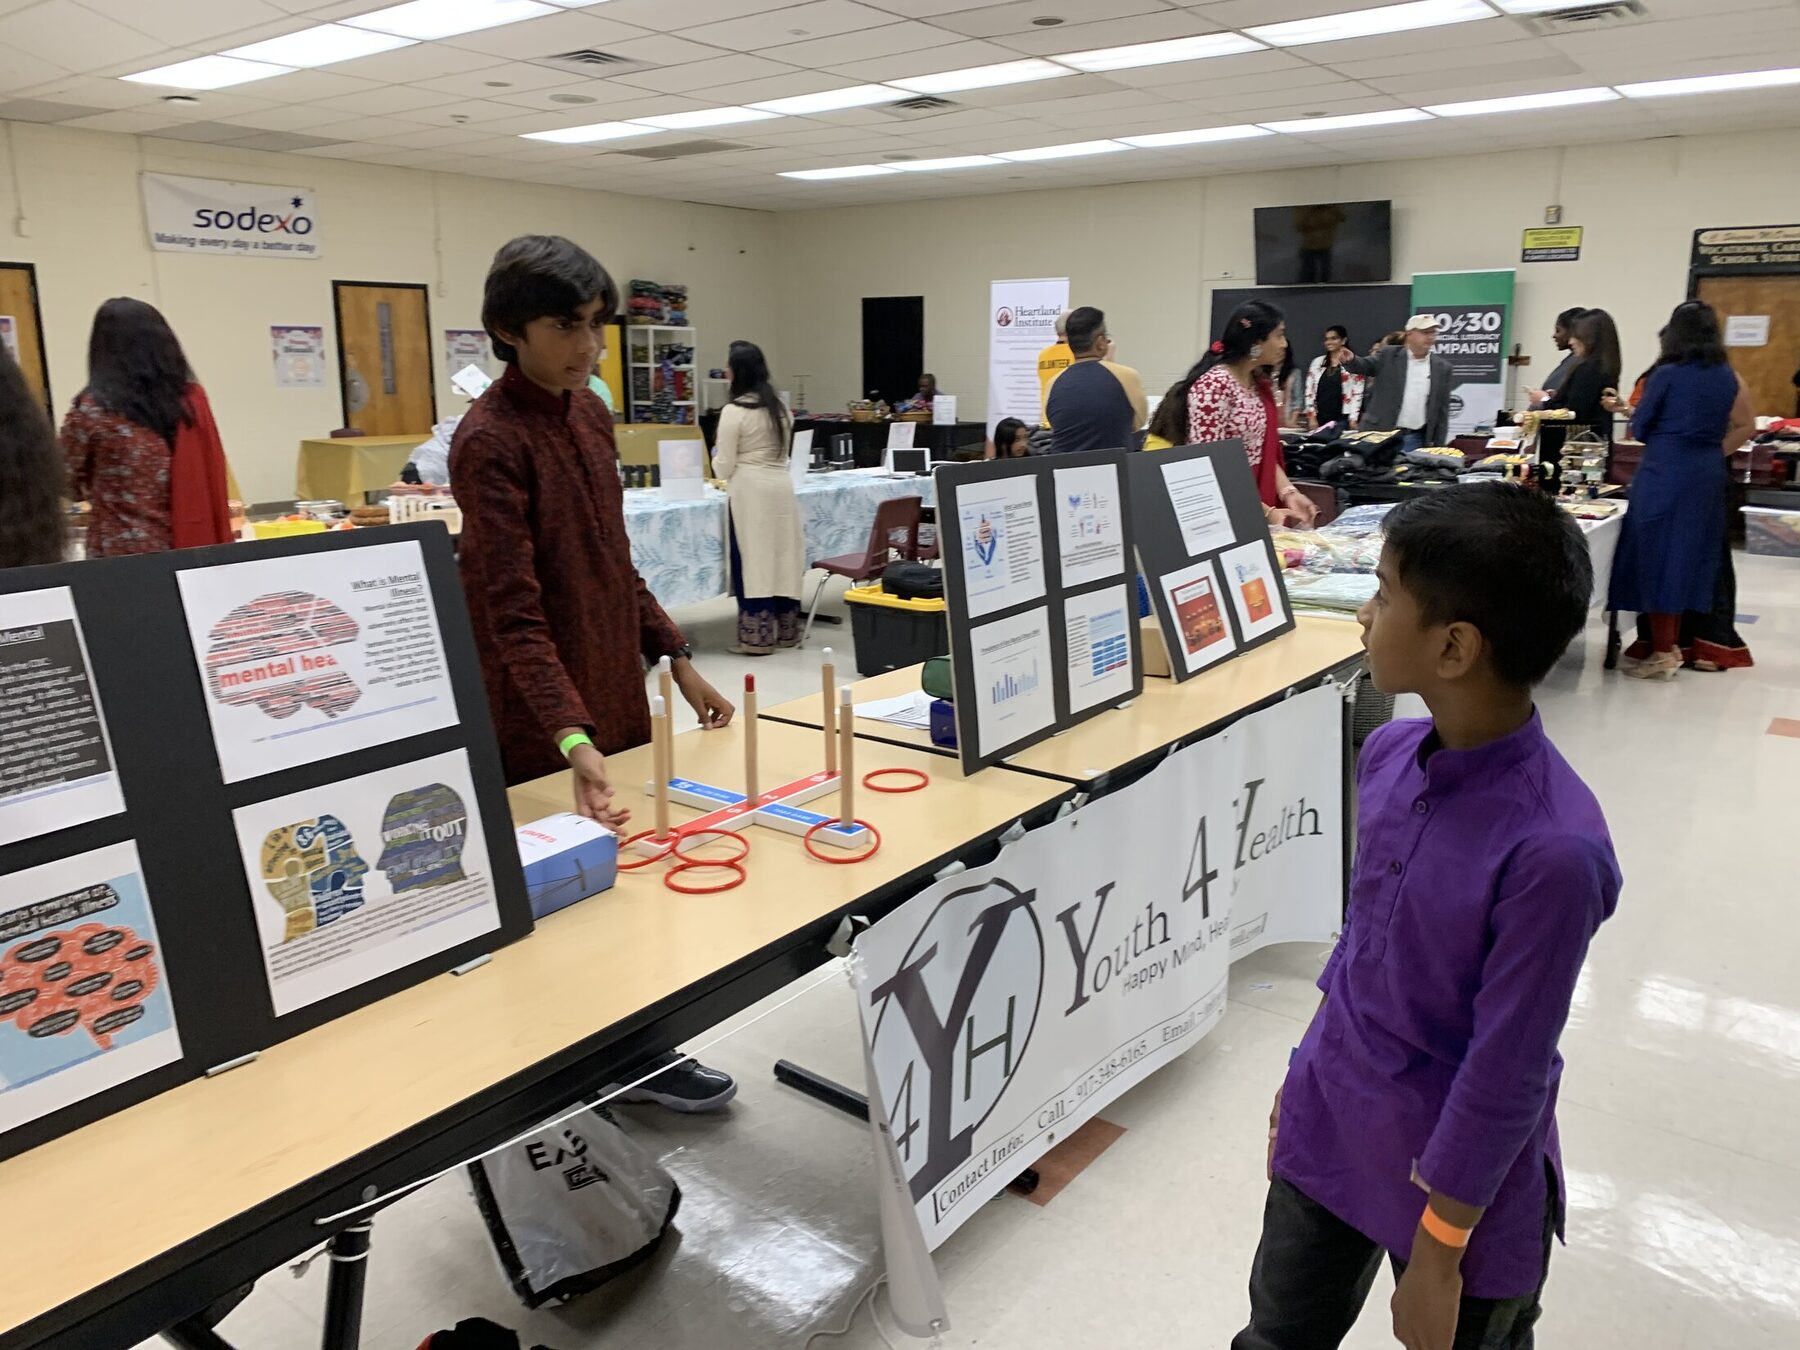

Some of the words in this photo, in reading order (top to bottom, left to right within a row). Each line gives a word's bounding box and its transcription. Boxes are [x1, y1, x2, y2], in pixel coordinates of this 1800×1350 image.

[193, 206, 312, 235] sodexo
[155, 232, 196, 248] Making
[200, 237, 229, 249] every
[232, 238, 249, 250] day
[262, 240, 293, 250] better
[297, 242, 316, 254] day
[1014, 316, 1052, 327] Institute
[1015, 304, 1062, 317] Heartland
[1430, 342, 1500, 354] AMPAIGN
[351, 579, 377, 590] What
[388, 572, 420, 584] Mental
[219, 657, 296, 688] mental
[432, 820, 463, 842] OUT
[1056, 881, 1171, 1018] Youth
[1182, 815, 1219, 920] 4
[1122, 956, 1168, 996] Happy
[938, 1159, 988, 1213] Contact
[991, 1133, 1025, 1167] Info:
[1037, 1099, 1065, 1130] Call
[1162, 1013, 1198, 1043] Email
